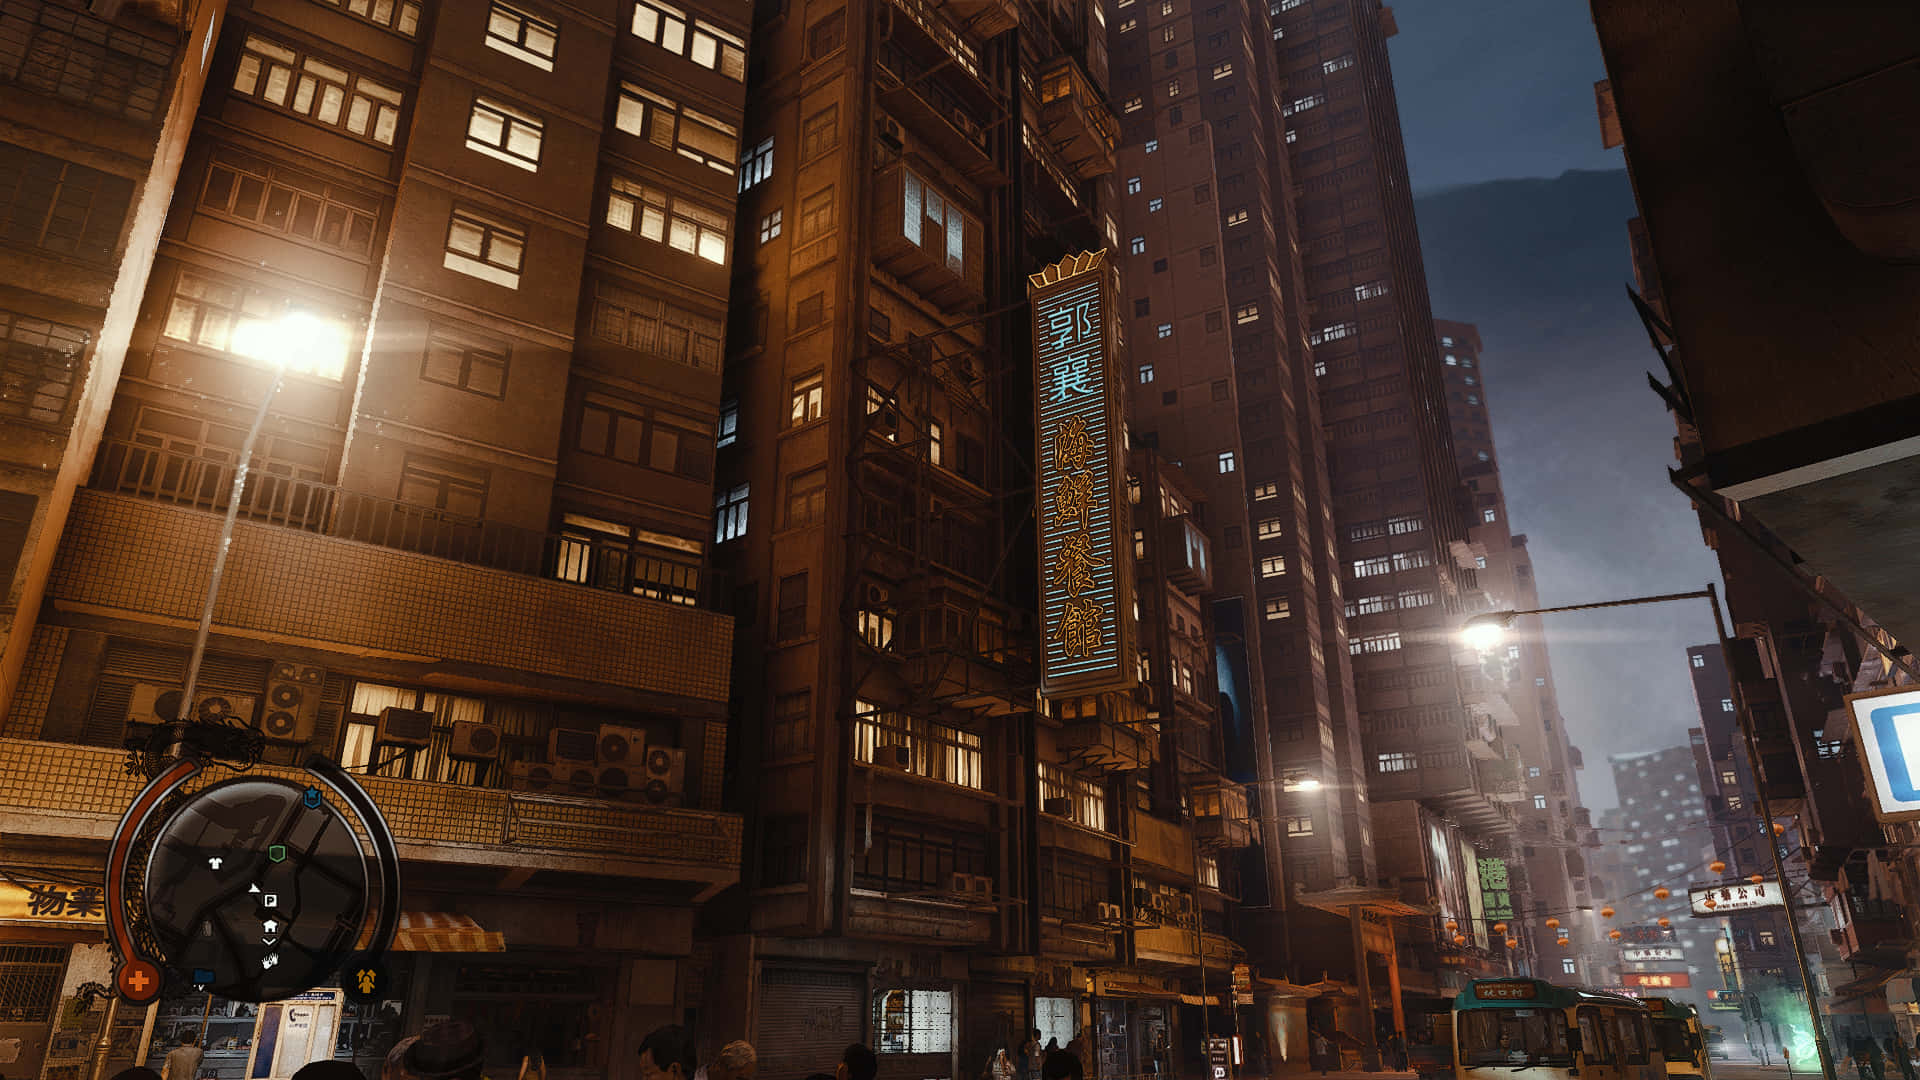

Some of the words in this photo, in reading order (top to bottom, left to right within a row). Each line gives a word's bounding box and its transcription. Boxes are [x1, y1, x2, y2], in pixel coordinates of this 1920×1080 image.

[1048, 302, 1105, 656] 郭襄海鮮餐館
[27, 885, 104, 917] 物業
